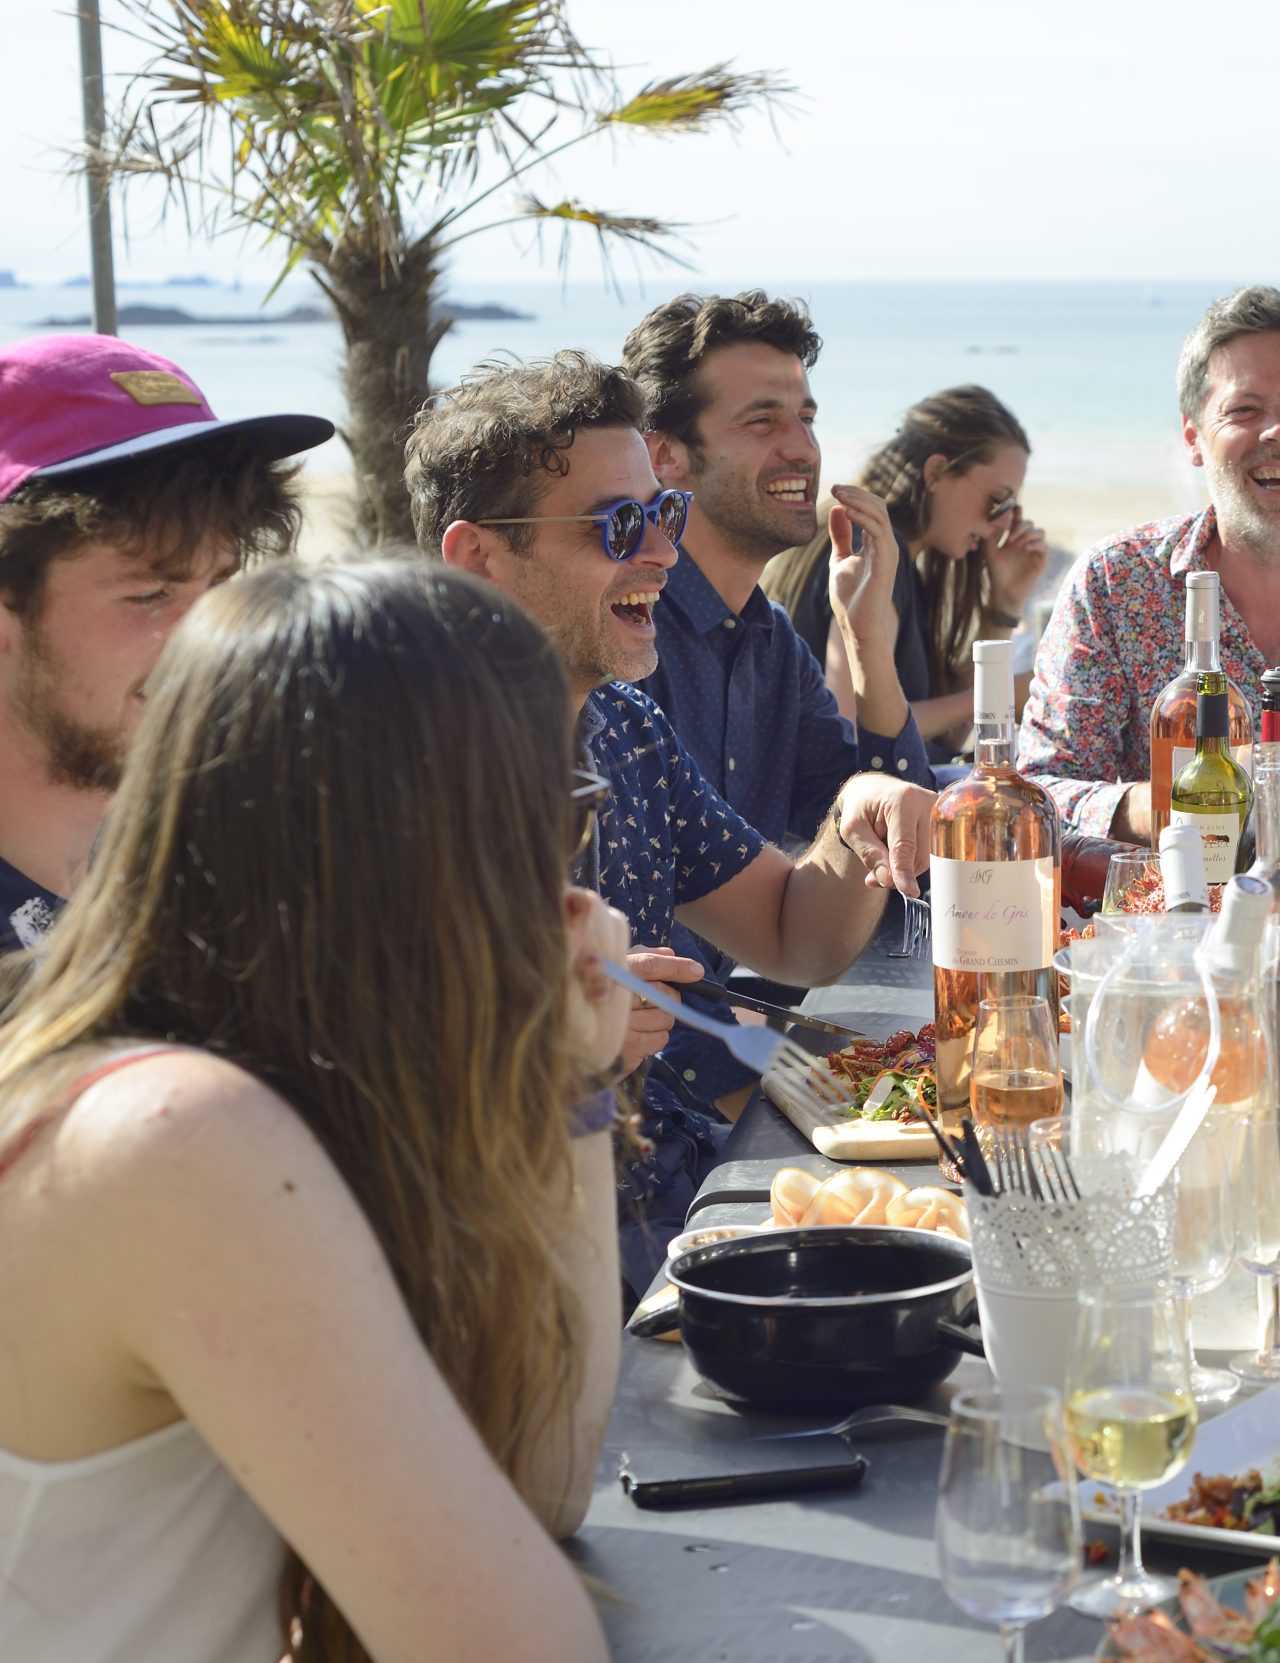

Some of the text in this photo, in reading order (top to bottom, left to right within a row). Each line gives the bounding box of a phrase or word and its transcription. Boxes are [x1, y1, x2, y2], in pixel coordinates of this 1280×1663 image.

[1202, 853, 1226, 862] melles
[945, 899, 1029, 927] Amour de Gris
[987, 956, 1018, 966] CHEMIN
